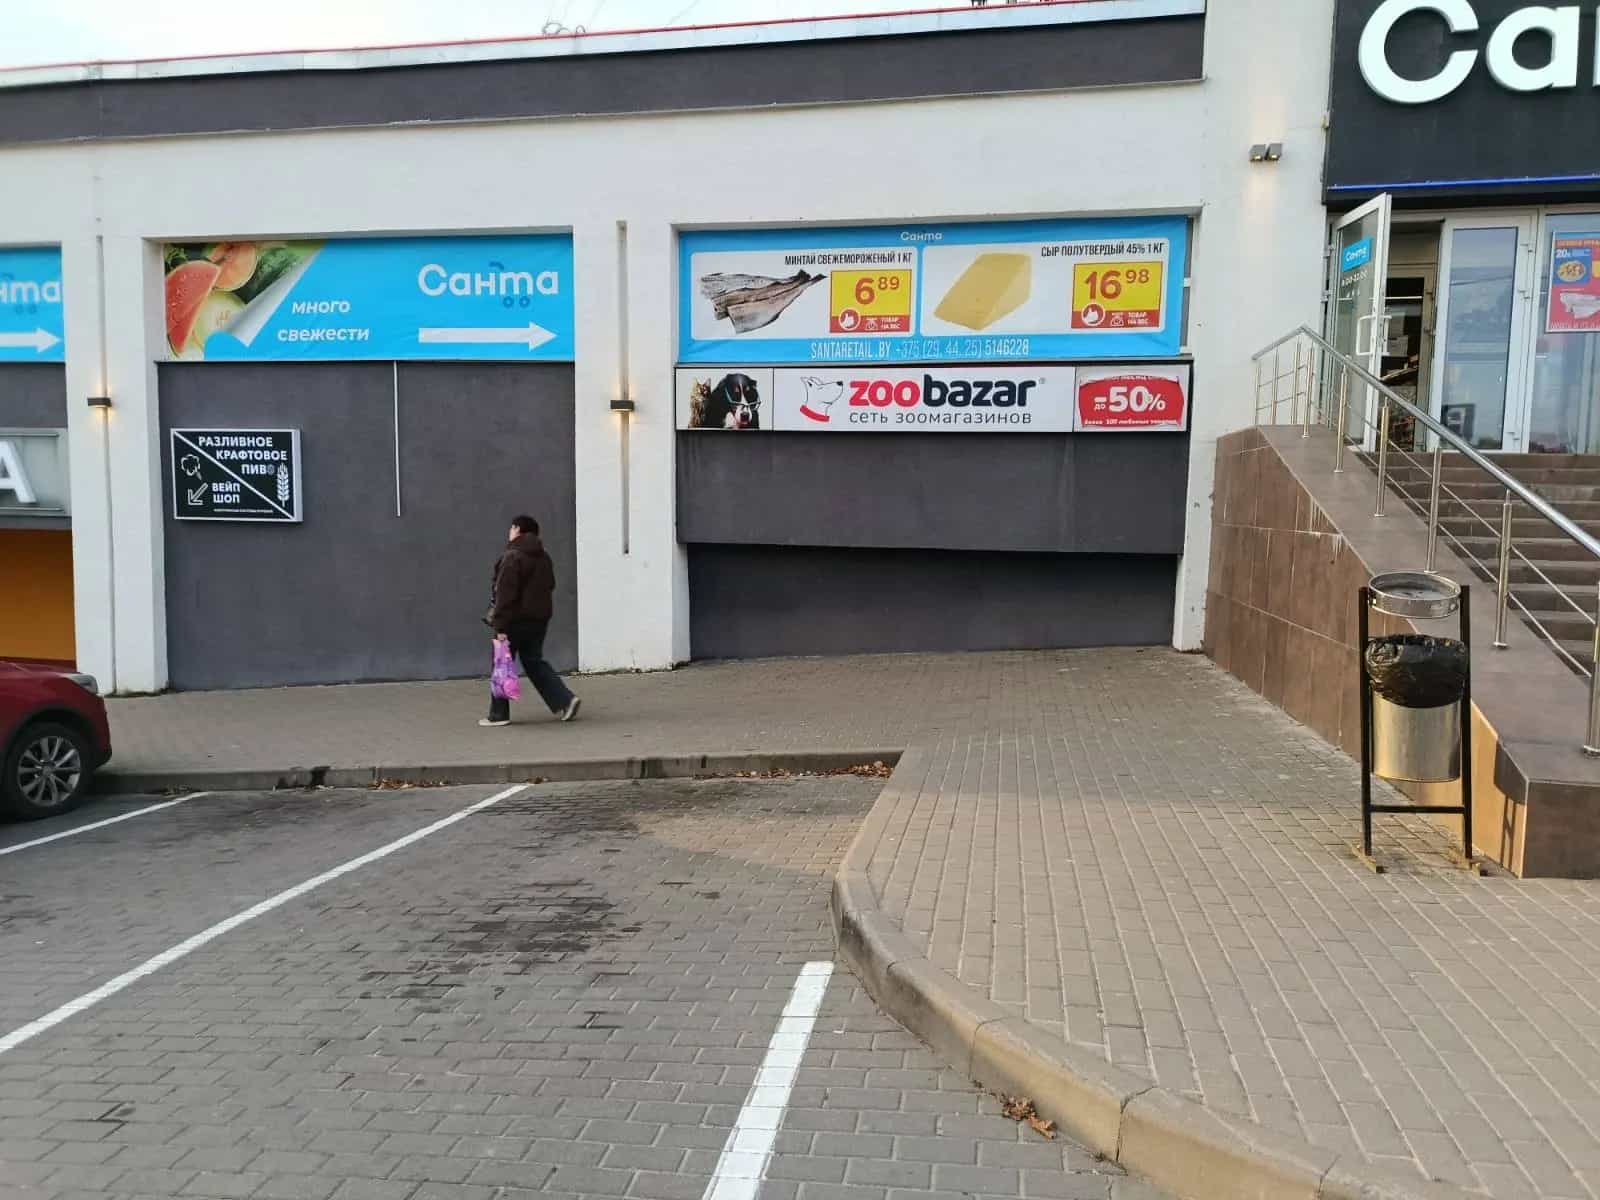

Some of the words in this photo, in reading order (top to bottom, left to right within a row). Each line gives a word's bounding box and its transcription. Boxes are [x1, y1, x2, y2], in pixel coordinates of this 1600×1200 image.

[1358, 0, 1600, 103] Са
[900, 231, 943, 241] Санта
[818, 250, 895, 265] СВЕЖЕМОРОЖЕНЫЙ
[902, 252, 912, 263] КГ
[1041, 246, 1059, 257] СЫР
[1061, 243, 1124, 256] ПОЛУТВЕРДЫЙ
[1126, 243, 1145, 254] 45%
[1153, 243, 1165, 253] КГ
[418, 263, 559, 296] Санта
[1084, 270, 1122, 300] 16
[1125, 269, 1150, 284] 98
[855, 278, 875, 305] 6
[878, 276, 900, 290] 89
[292, 299, 350, 314] много
[277, 327, 370, 342] свежести
[984, 338, 1030, 356] 5146228
[849, 374, 1037, 407] zoobazar
[849, 412, 888, 424] сеть
[895, 412, 1032, 424] зоомагазинов
[198, 436, 273, 447] РАЗЛИВНОЕ
[216, 450, 288, 461] КРАФТОВОЕ
[212, 481, 241, 492] ВЕЙП
[213, 494, 240, 504] ШОП
